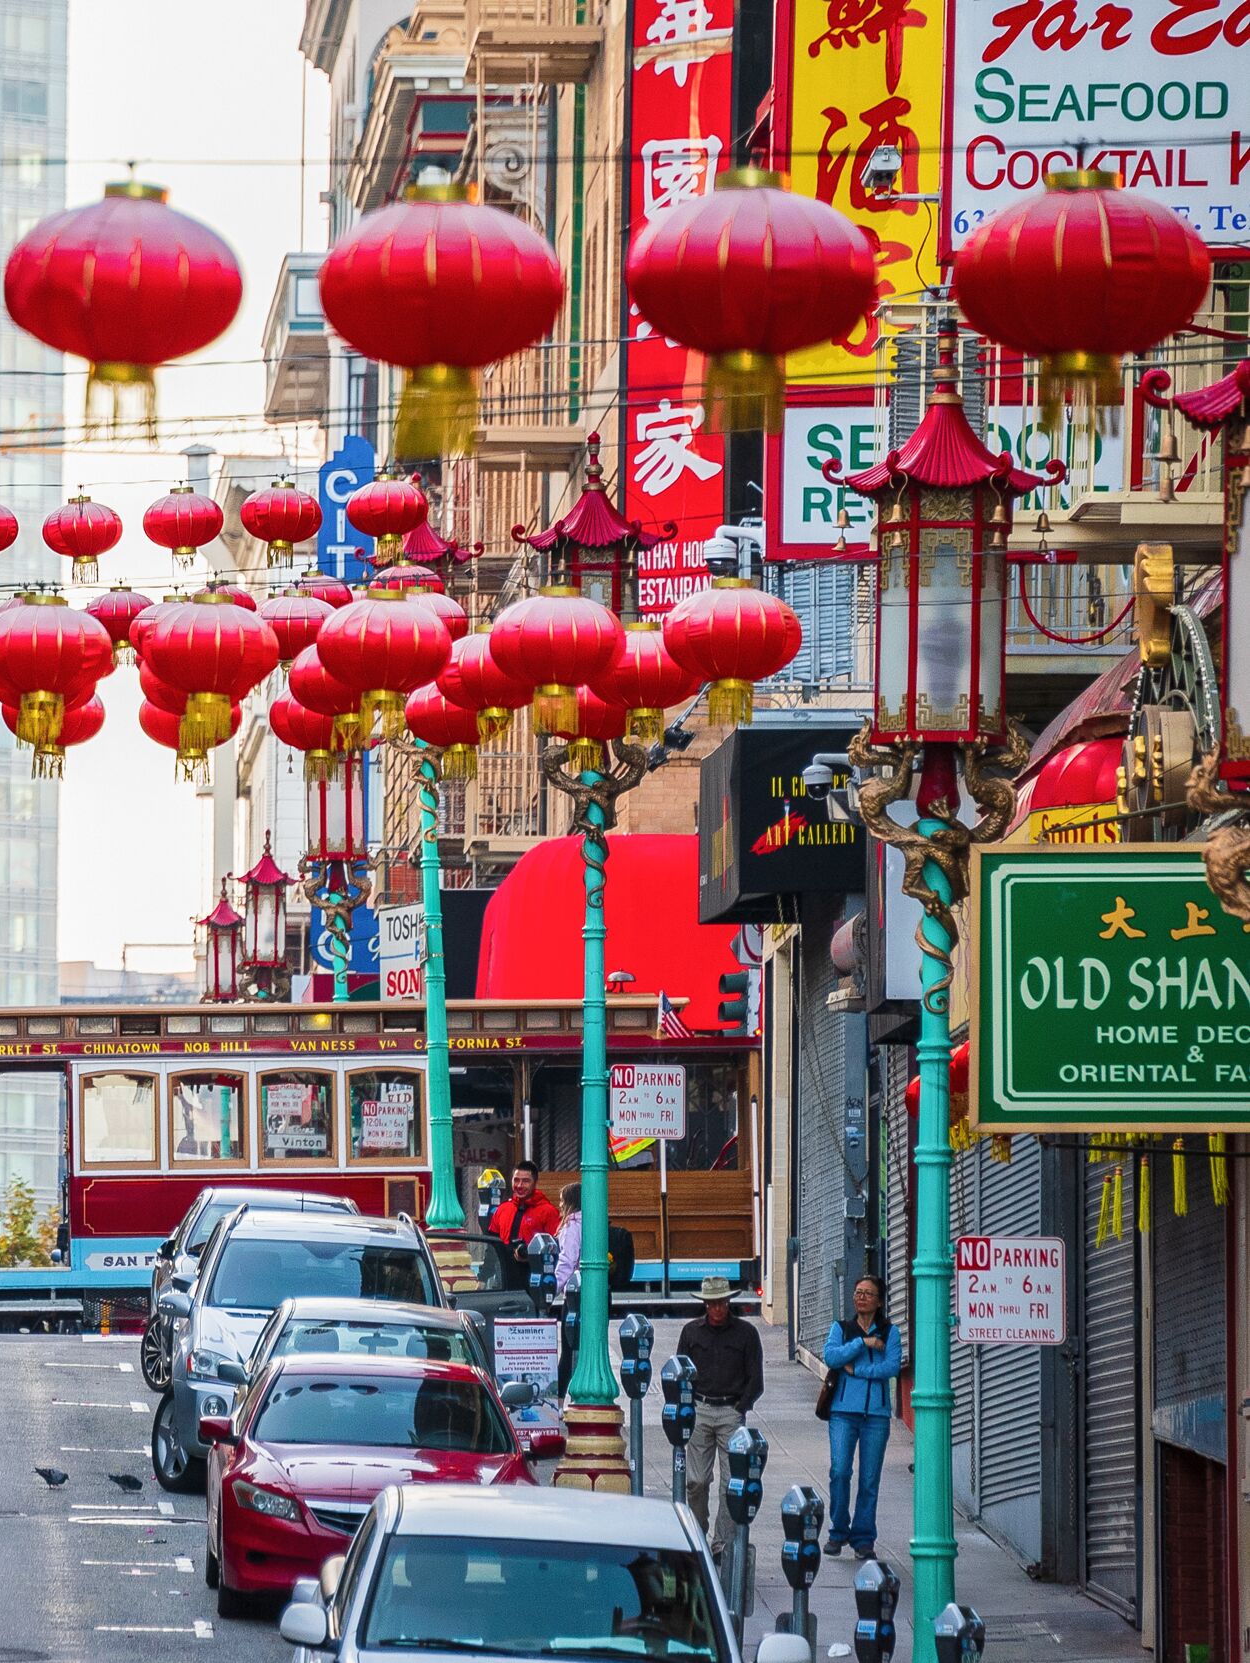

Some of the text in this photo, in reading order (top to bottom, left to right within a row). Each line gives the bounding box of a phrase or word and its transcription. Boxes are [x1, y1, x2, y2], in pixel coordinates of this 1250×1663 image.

[974, 66, 1229, 124] SEAFOOD
[638, 542, 678, 570] ATHAY
[766, 822, 855, 846] ART GALLERY
[386, 967, 421, 998] SON
[1020, 956, 1111, 1010] OLD
[1097, 1026, 1178, 1043] HOME
[83, 1042, 160, 1054] CHINATOWN
[184, 1042, 251, 1054] NOB HILL
[291, 1040, 356, 1052] VAN NESS
[414, 1038, 499, 1050] CFORNIA
[1187, 1045, 1204, 1063] &
[614, 1067, 681, 1087] NO PARKING
[1059, 1064, 1250, 1083] ORIENTAL FA
[619, 1090, 627, 1104] 2
[655, 1091, 663, 1105] 6
[363, 1103, 407, 1116] NO PARKING
[619, 1110, 674, 1122] MON THRU FRI
[618, 1127, 678, 1137] STREET CLEANING
[282, 1137, 323, 1147] Vinton
[459, 1151, 486, 1164] SALE
[103, 1256, 137, 1267] SAN
[961, 1241, 1059, 1268] NO PARKING
[968, 1274, 979, 1294] 2
[1005, 1277, 1013, 1285] TO
[1022, 1275, 1033, 1294] 6
[969, 1302, 1049, 1319] MON THRU FRI
[968, 1328, 1055, 1339] STREET CLEANING
